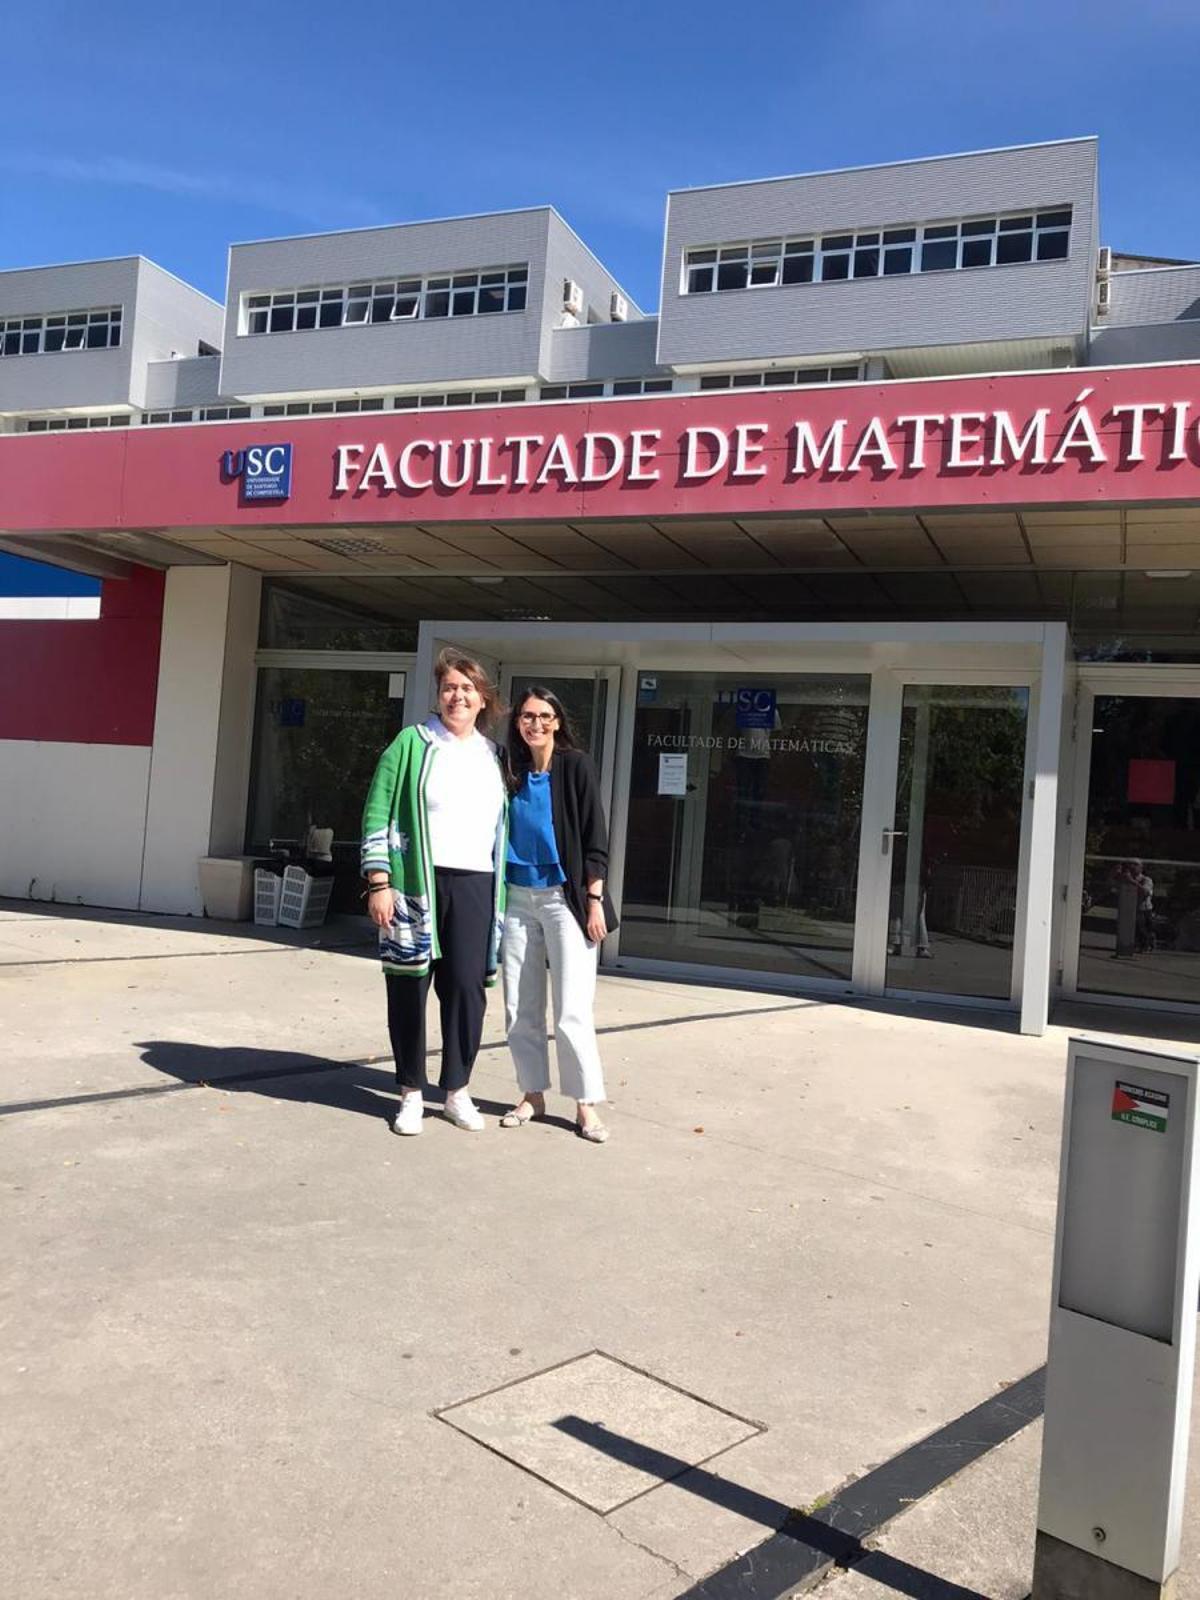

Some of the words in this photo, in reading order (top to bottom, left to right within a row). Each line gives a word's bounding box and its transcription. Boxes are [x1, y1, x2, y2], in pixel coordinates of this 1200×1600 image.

[334, 429, 661, 493] FACULTADE
[682, 423, 769, 479] DE
[791, 387, 1200, 475] MATEMÁTI
[223, 446, 285, 477] USC
[646, 733, 723, 749] FACULTADE
[727, 736, 745, 749] DE
